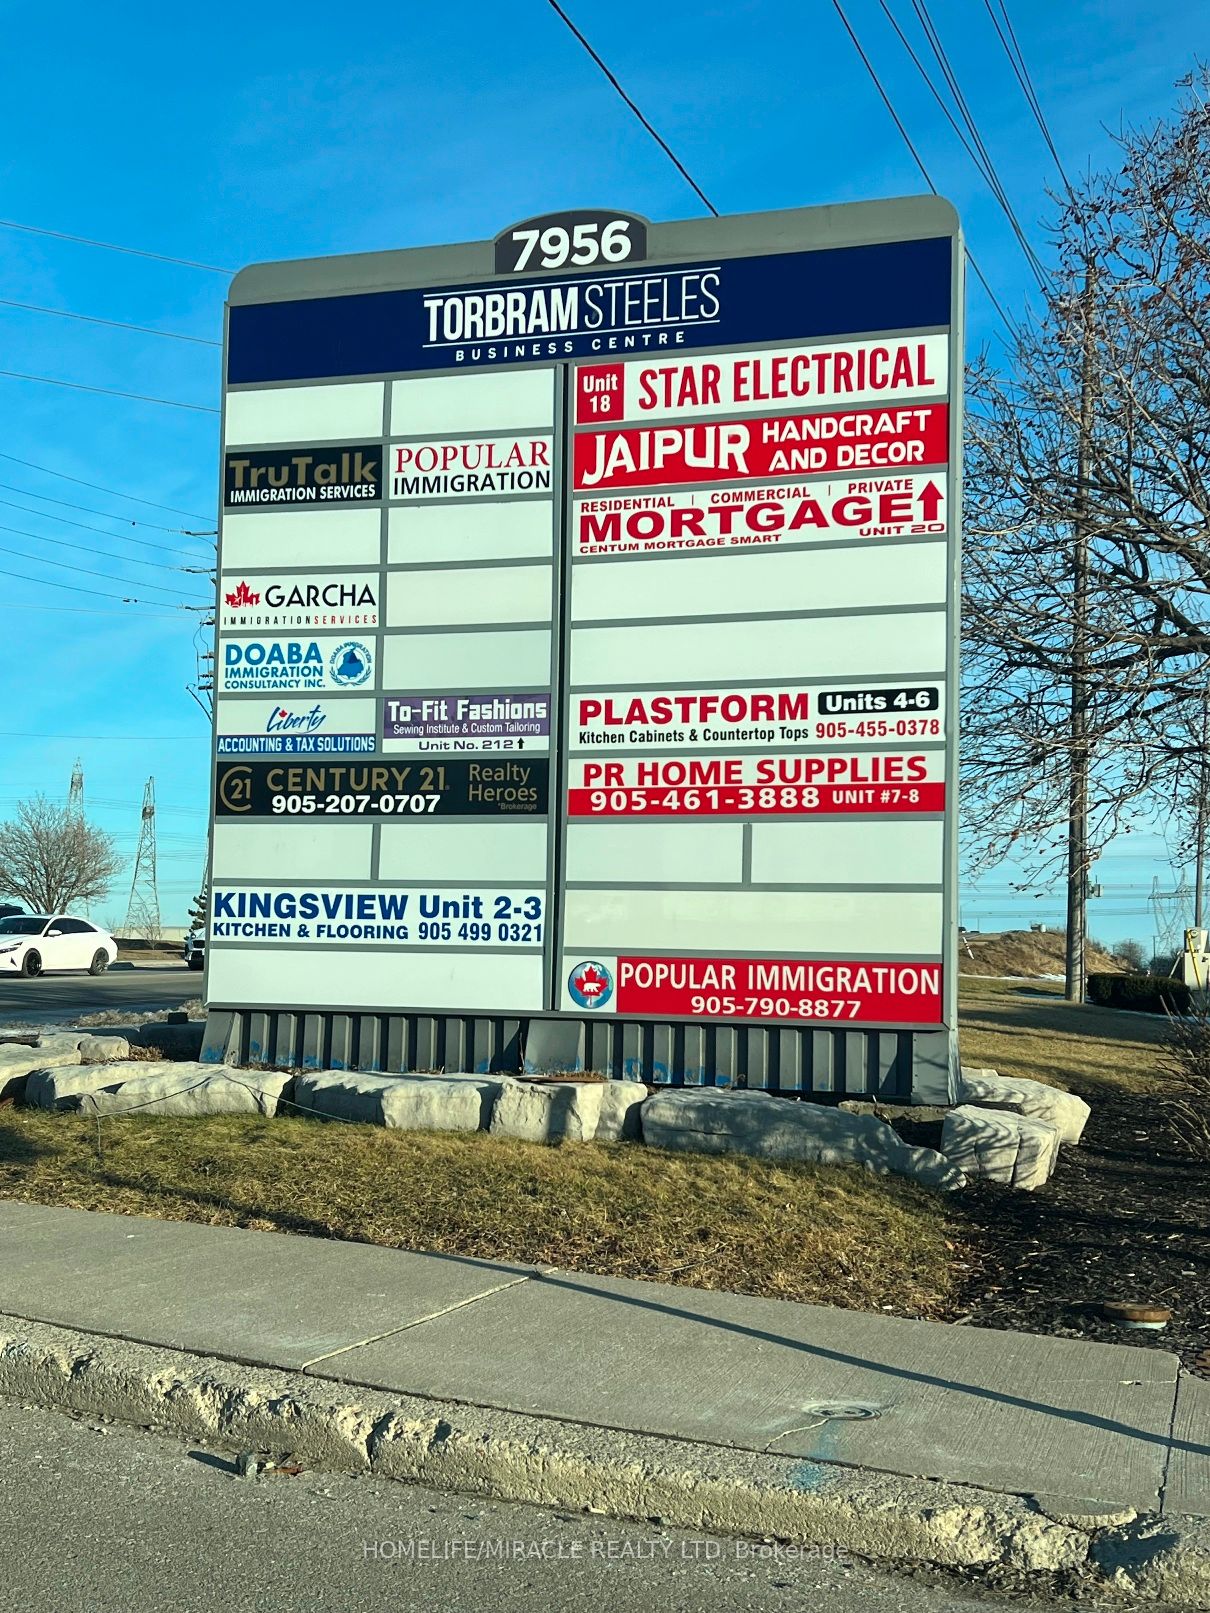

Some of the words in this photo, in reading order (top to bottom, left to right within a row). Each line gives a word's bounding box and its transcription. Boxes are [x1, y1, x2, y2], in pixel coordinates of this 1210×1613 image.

[512, 220, 632, 272] 7956
[423, 286, 578, 342] TORBRAM
[584, 273, 721, 329] STEELES
[456, 341, 573, 361] BUSINESS
[591, 331, 685, 350] CENTRE
[583, 373, 618, 393] Unit
[638, 363, 721, 410] STAR
[733, 344, 935, 402] ELECTRICAL
[590, 394, 611, 413] 18
[762, 409, 932, 444] HANDCRAFT
[395, 441, 550, 473] POPULAR
[581, 424, 750, 486] JAIPUR
[768, 447, 828, 472] AND
[836, 439, 925, 467] DECOR
[229, 452, 378, 488] TruTalk
[230, 486, 316, 503] IMMIGRATION
[319, 484, 376, 500] SERVICES
[393, 470, 550, 496] IMMIGRATION
[581, 496, 675, 513] RESIDENTIAL
[711, 486, 811, 504] COMMERCIAL
[848, 478, 914, 494] PRIVATE
[579, 493, 914, 543] MORTGAGE
[859, 525, 905, 537] UNIT
[910, 523, 945, 534] 20
[579, 543, 640, 554] CENTUM
[644, 537, 726, 550] MORTGAGE
[729, 534, 782, 546] SMART
[265, 583, 377, 607] GARCHA
[225, 642, 323, 666] DOABA
[224, 679, 300, 689] CONSULTANCY
[304, 678, 326, 688] INC.
[225, 665, 323, 679] IMMIGRATION
[387, 700, 448, 722] To-Fit
[456, 698, 547, 721] Fashions
[579, 692, 809, 726] PLASTFORM
[825, 692, 887, 712] Units
[893, 691, 930, 708] 4-6
[266, 704, 327, 734] Liberty
[393, 724, 424, 736] Sewing
[426, 723, 459, 734] Institute
[461, 724, 469, 734] &
[470, 723, 503, 734] Custom
[505, 722, 541, 734] Tailoring
[815, 719, 940, 739] 905-455-0378
[218, 737, 282, 752] ACCOUNTING
[285, 739, 293, 751] &
[296, 737, 315, 751] TAX
[317, 736, 375, 751] SOLUTIONS
[418, 741, 450, 750] Unit
[453, 740, 478, 750] No.
[482, 739, 514, 749] 212
[579, 731, 625, 744] Kitchen
[629, 729, 684, 743] Cabinets
[688, 730, 698, 742] &
[702, 727, 775, 743] Countertop
[779, 726, 809, 742] Tops
[266, 767, 411, 792] CENTURY
[469, 762, 531, 785] Realty
[583, 762, 625, 787] PR
[637, 760, 743, 786] HOME
[756, 756, 928, 784] SUPPLIES
[272, 794, 441, 814] 905-207-0707
[468, 783, 538, 802] Heroes
[590, 787, 820, 812] 905-461-3888
[832, 790, 874, 805] UNIT
[880, 789, 920, 804] #7-8
[213, 892, 409, 920] KINGSVIEW
[418, 894, 483, 919] Unit
[493, 895, 542, 919] 2-3
[213, 922, 291, 937] KITCHEN
[296, 924, 310, 938] &
[316, 924, 409, 940] FLOORING
[418, 921, 451, 941] 905
[457, 922, 491, 941] 499
[498, 923, 542, 942] 0321
[620, 962, 736, 990] POPULAR
[747, 964, 940, 996] IMMIGRATION
[690, 996, 862, 1018] 905-790-8877
